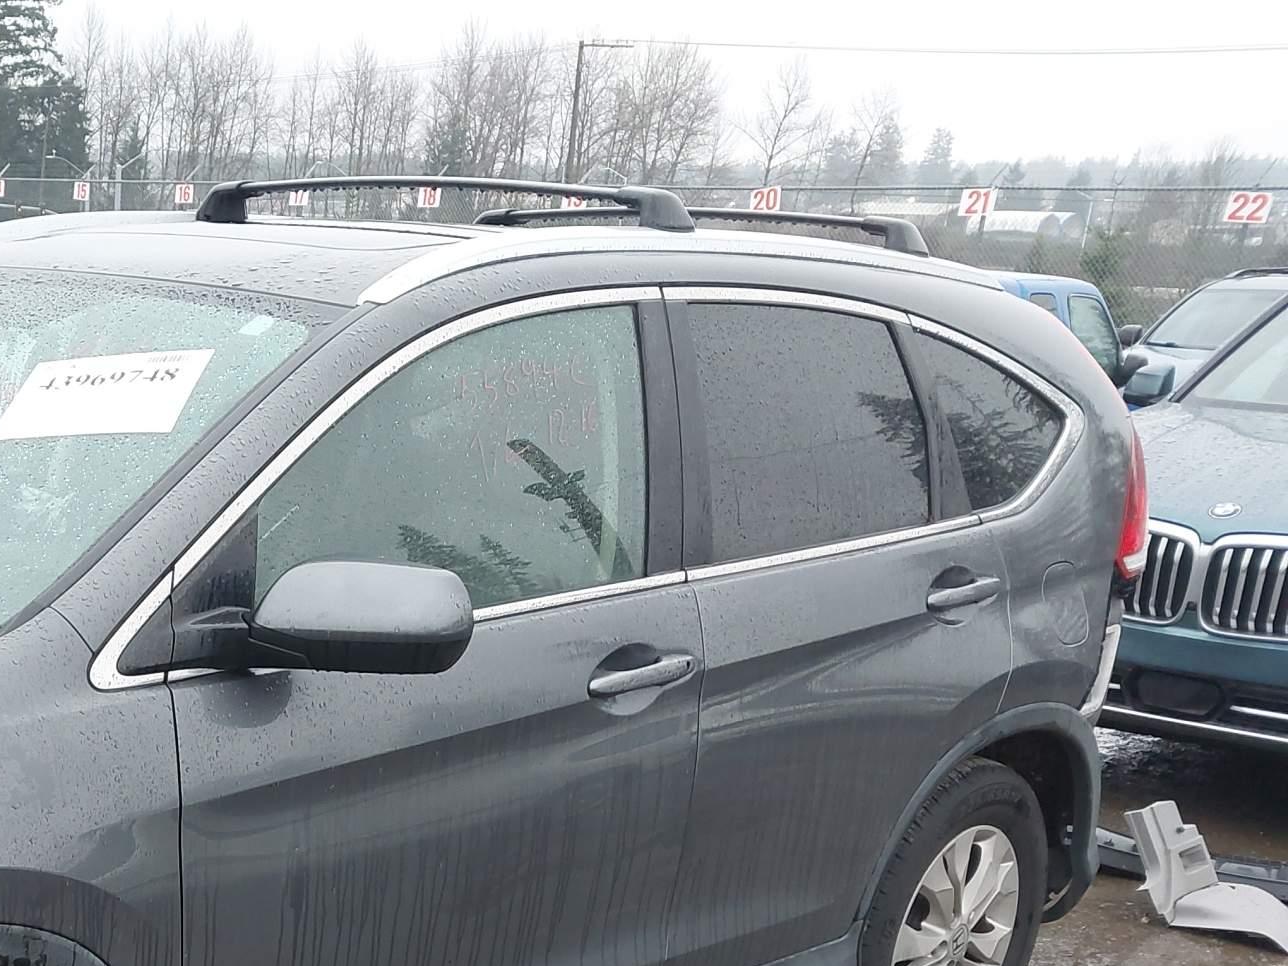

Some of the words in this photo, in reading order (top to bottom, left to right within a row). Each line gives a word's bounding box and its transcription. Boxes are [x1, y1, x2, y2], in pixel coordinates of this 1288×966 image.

[76, 185, 87, 199] 15
[177, 185, 190, 202] 16
[422, 187, 436, 206] 18
[753, 188, 778, 211] 20
[965, 190, 991, 214] 21
[1227, 193, 1269, 221] 22
[40, 367, 180, 390] 43969748
